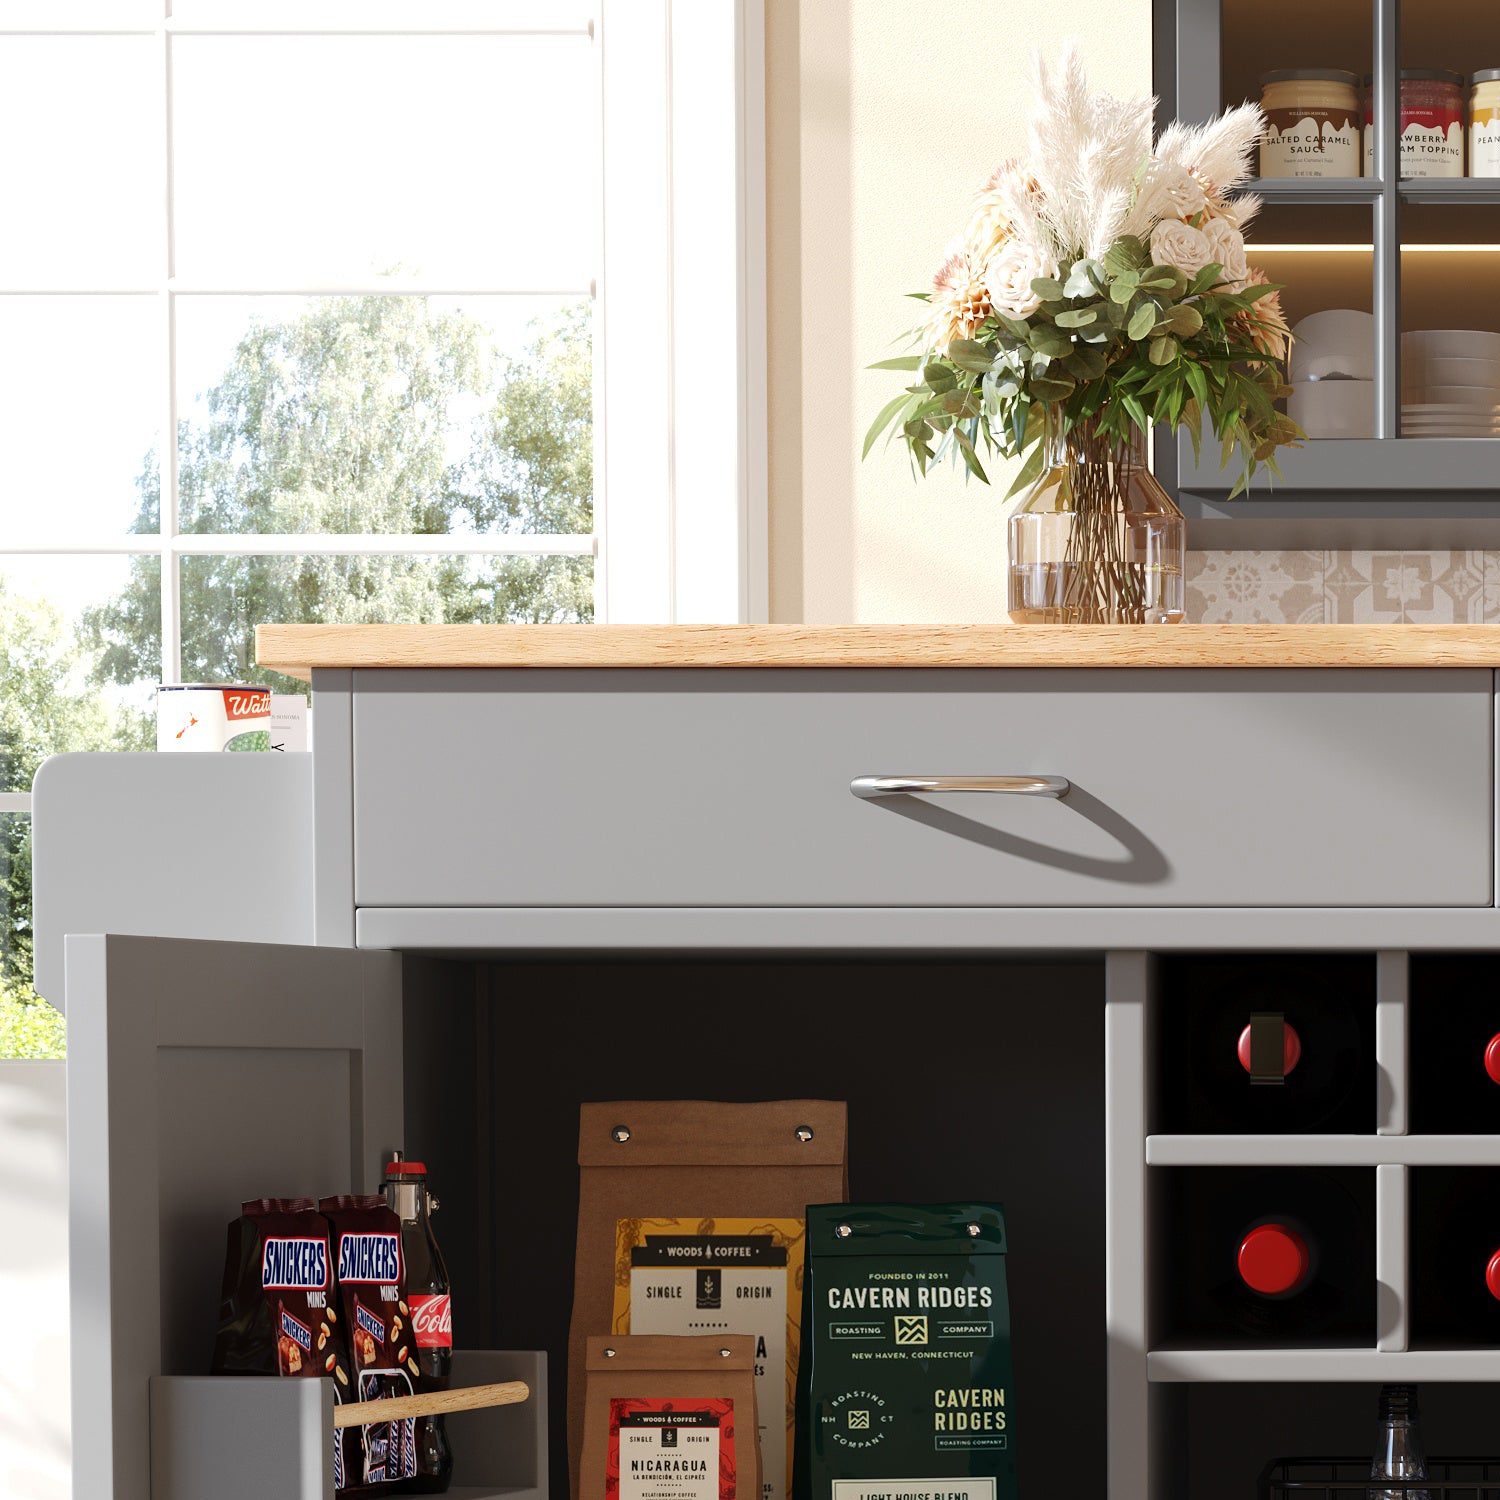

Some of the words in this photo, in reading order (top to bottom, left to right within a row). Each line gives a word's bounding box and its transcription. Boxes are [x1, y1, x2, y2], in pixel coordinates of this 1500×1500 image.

[1267, 136, 1300, 146] SALTED
[1305, 136, 1350, 146] CARAMEL
[1400, 135, 1446, 143] AWBERRY
[1420, 146, 1459, 156] TOPPING
[339, 1236, 398, 1280] SNICKERS
[667, 1247, 702, 1257] WOODS
[714, 1247, 751, 1257] COFFEE
[263, 1241, 326, 1286] SNICKERS
[306, 1291, 326, 1308] MINIS
[380, 1285, 399, 1301] MINIS
[646, 1286, 682, 1299] SINGLE
[736, 1286, 772, 1298] ORIGIN
[828, 1287, 910, 1309] CAVERN
[918, 1286, 993, 1308] RIDGES
[282, 1313, 311, 1350] SNICKERS
[357, 1307, 384, 1342] SNICKERS
[875, 1352, 908, 1360] HAVEN,
[911, 1351, 974, 1359] CONNECTICUT
[831, 1390, 886, 1407] ROASTING
[935, 1389, 1005, 1408] CAVERN
[935, 1411, 1006, 1431] RIDGES
[833, 1432, 885, 1448] COMPANY
[631, 1460, 707, 1471] NICARAGUA
